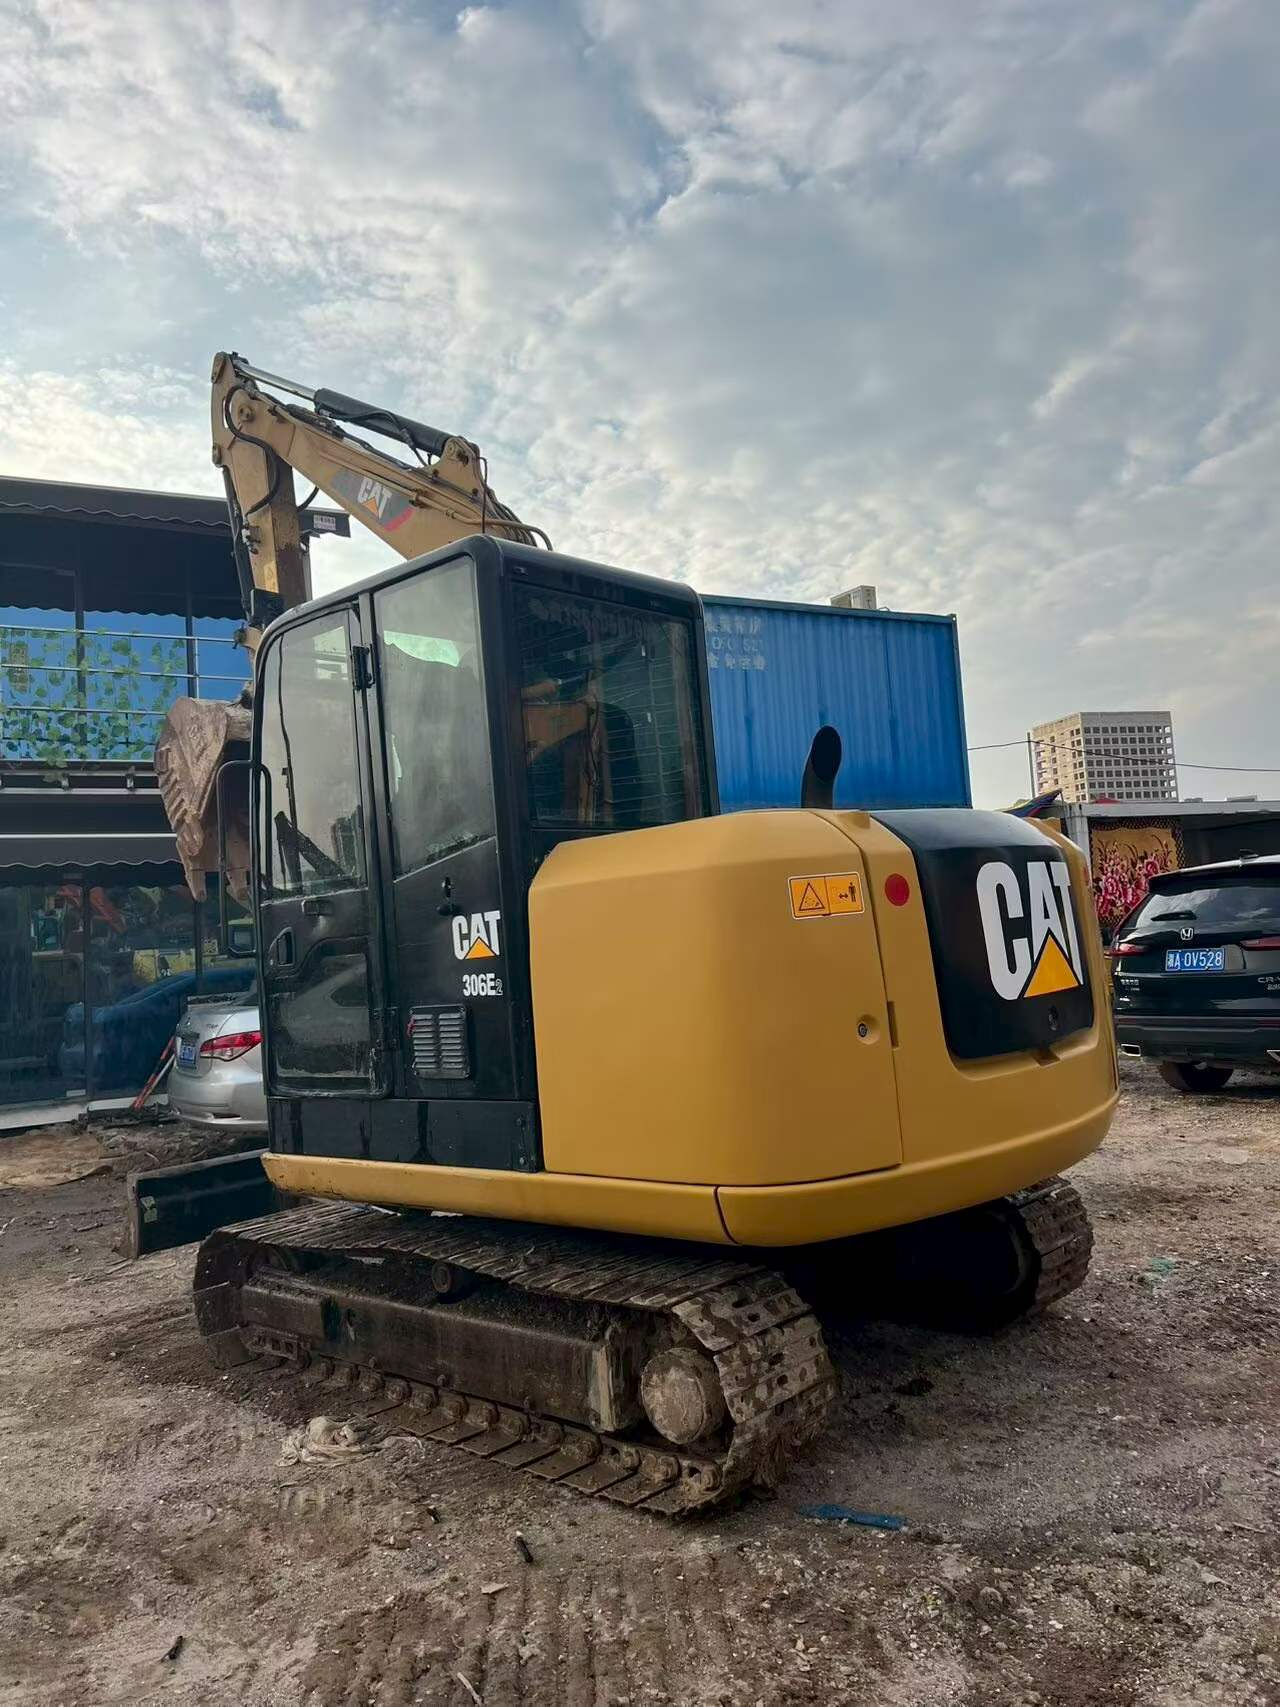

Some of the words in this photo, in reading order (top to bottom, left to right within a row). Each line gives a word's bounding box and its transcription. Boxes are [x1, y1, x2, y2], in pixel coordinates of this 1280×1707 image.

[357, 476, 392, 519] CAT
[452, 910, 501, 960] CAT
[976, 861, 1084, 1000] CAT
